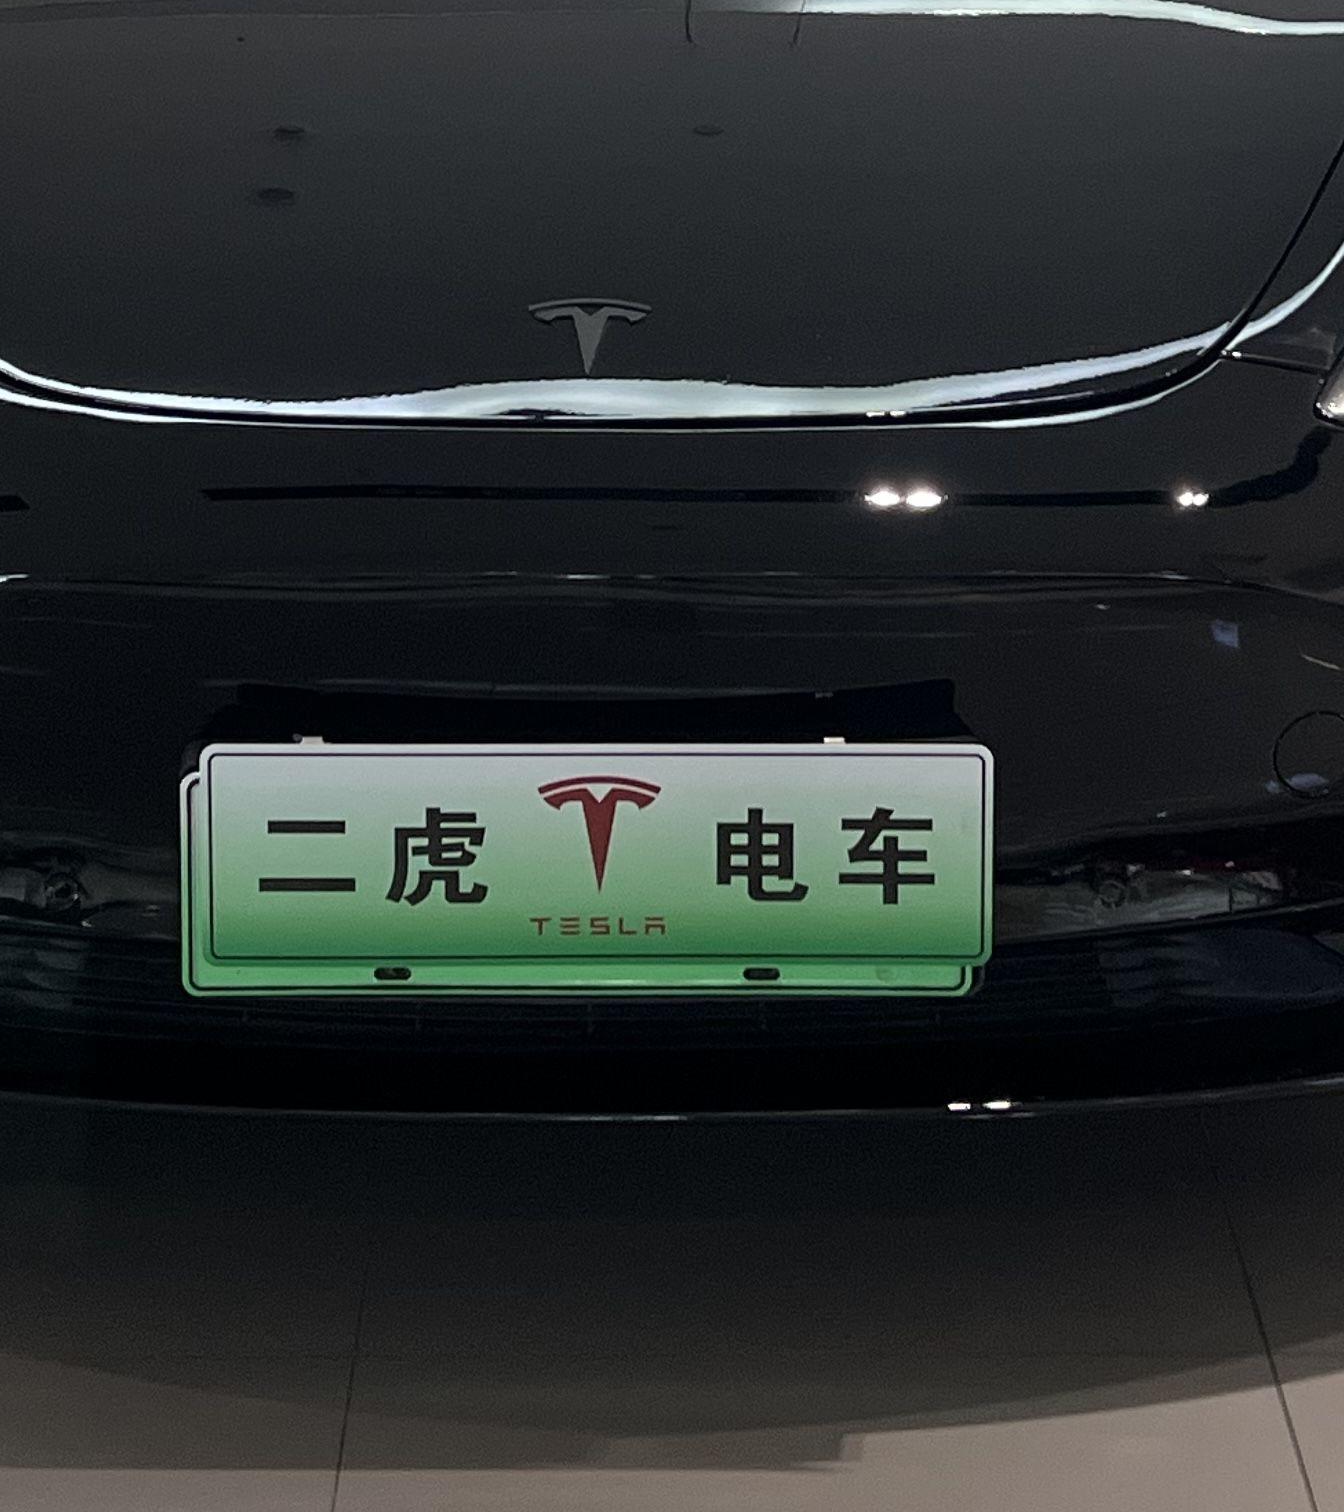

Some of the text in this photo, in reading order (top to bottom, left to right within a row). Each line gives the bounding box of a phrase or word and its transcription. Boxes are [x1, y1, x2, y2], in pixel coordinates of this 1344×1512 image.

[259, 806, 935, 906] 二虎 电车
[529, 916, 666, 936] TESLA
